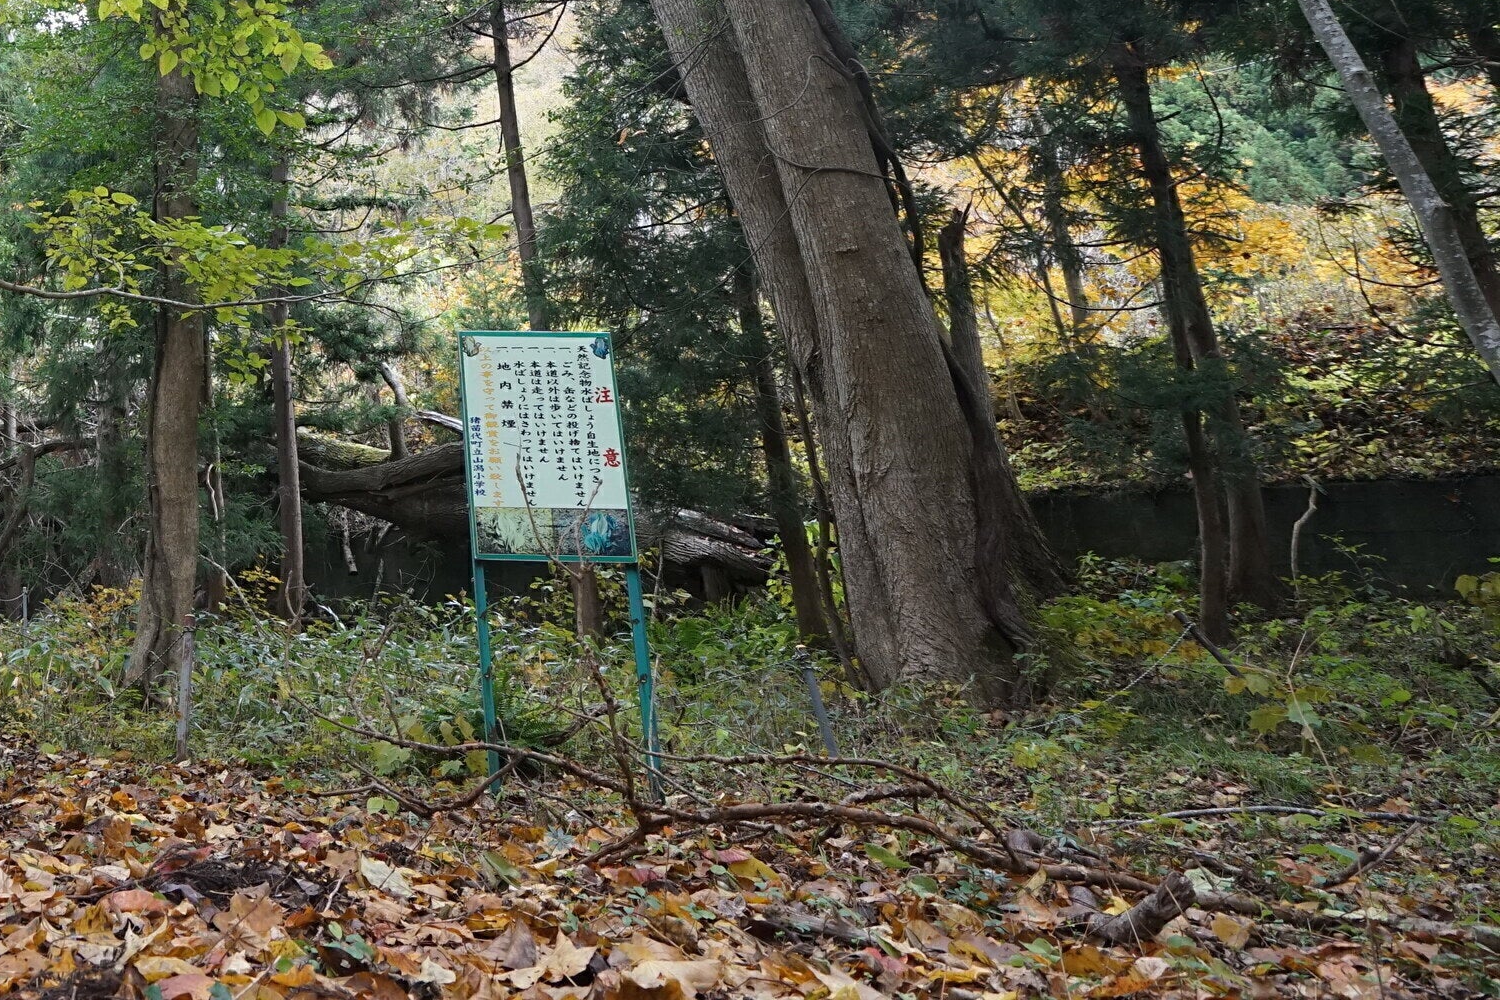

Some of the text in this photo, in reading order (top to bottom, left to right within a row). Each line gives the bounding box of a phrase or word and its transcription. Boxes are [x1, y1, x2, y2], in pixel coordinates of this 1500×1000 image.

[577, 345, 600, 485] 天然記念物水ばしょう自生地につき
[594, 386, 620, 468] 注意
